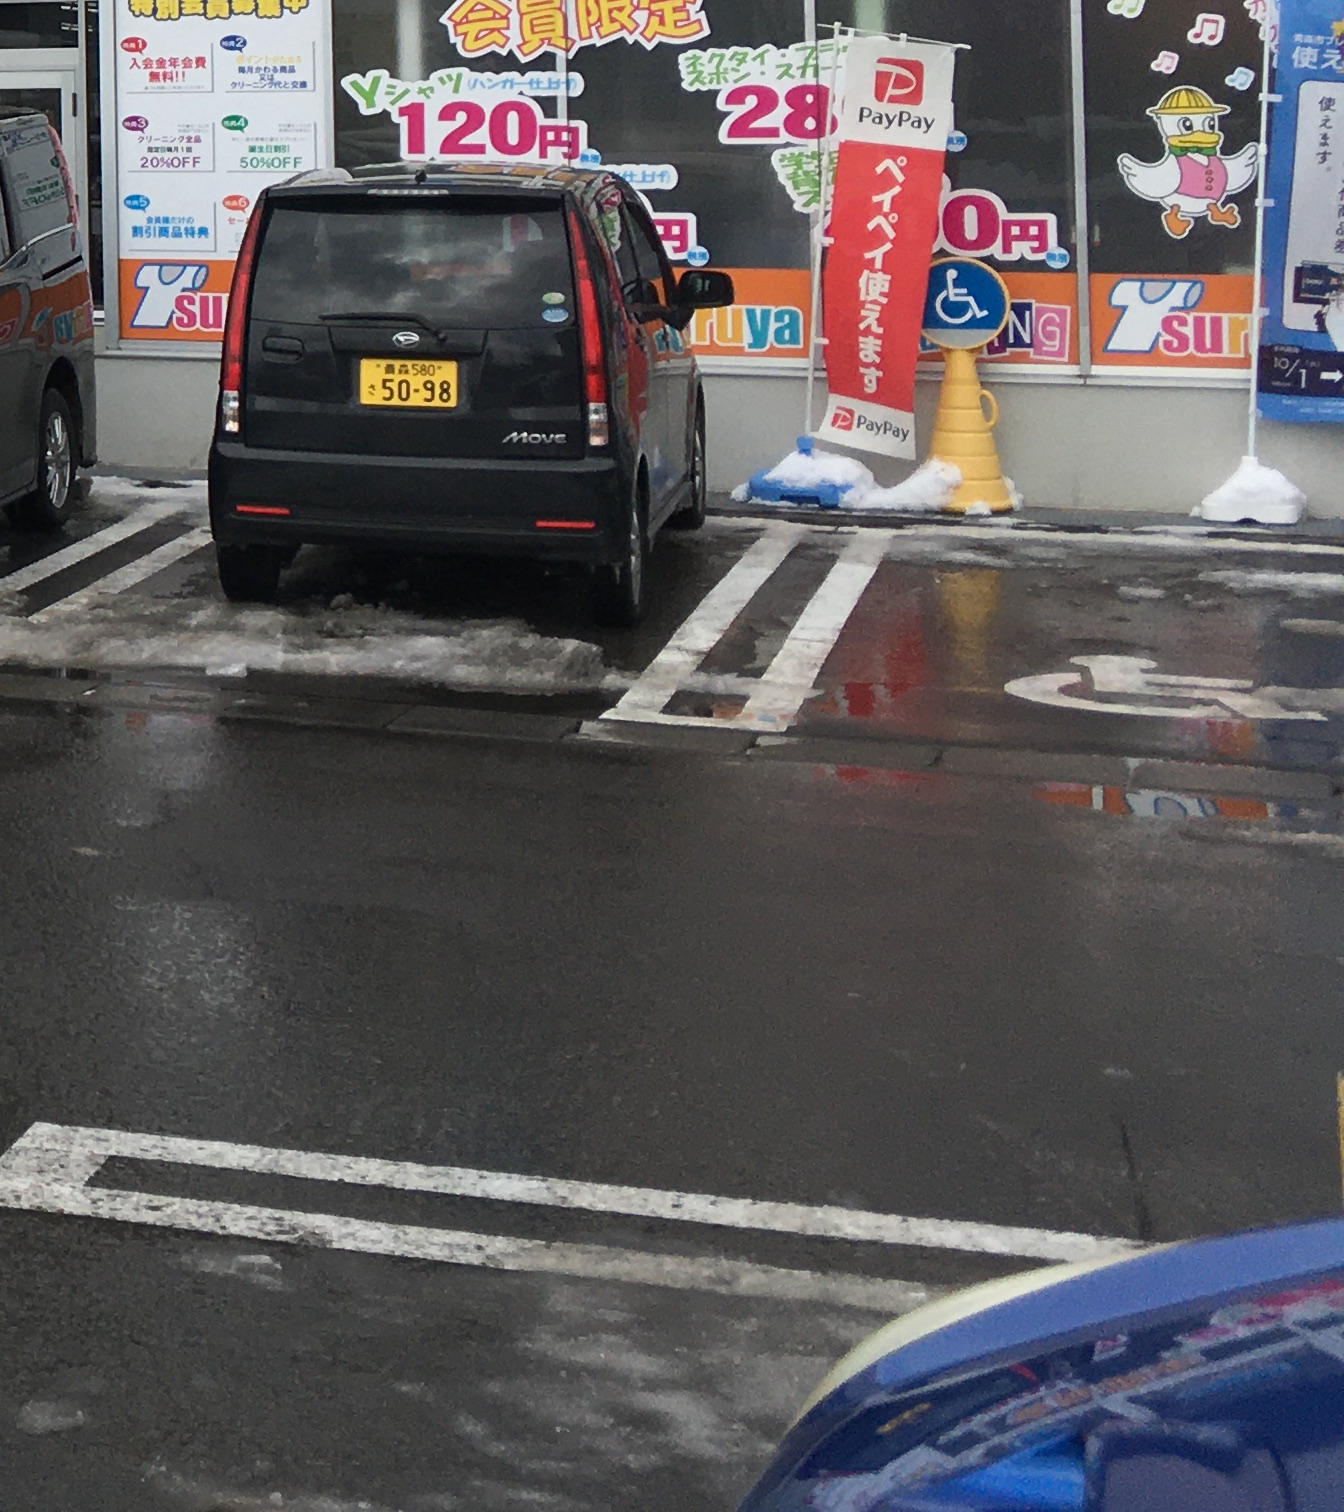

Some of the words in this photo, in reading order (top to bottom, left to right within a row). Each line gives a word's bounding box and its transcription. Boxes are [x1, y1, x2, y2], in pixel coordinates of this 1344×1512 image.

[129, 56, 207, 70] 入会金年会費
[350, 72, 463, 109] Yシャツ
[725, 84, 845, 139] 28
[858, 106, 935, 134] PayPay
[398, 100, 580, 160] 120円
[140, 156, 201, 169] 20%OFF
[240, 156, 302, 169] 50%OFF
[943, 194, 1049, 255] 0円
[858, 155, 908, 394] ペイペイ使えます
[381, 378, 452, 403] 50-98
[856, 414, 910, 442] PayPay
